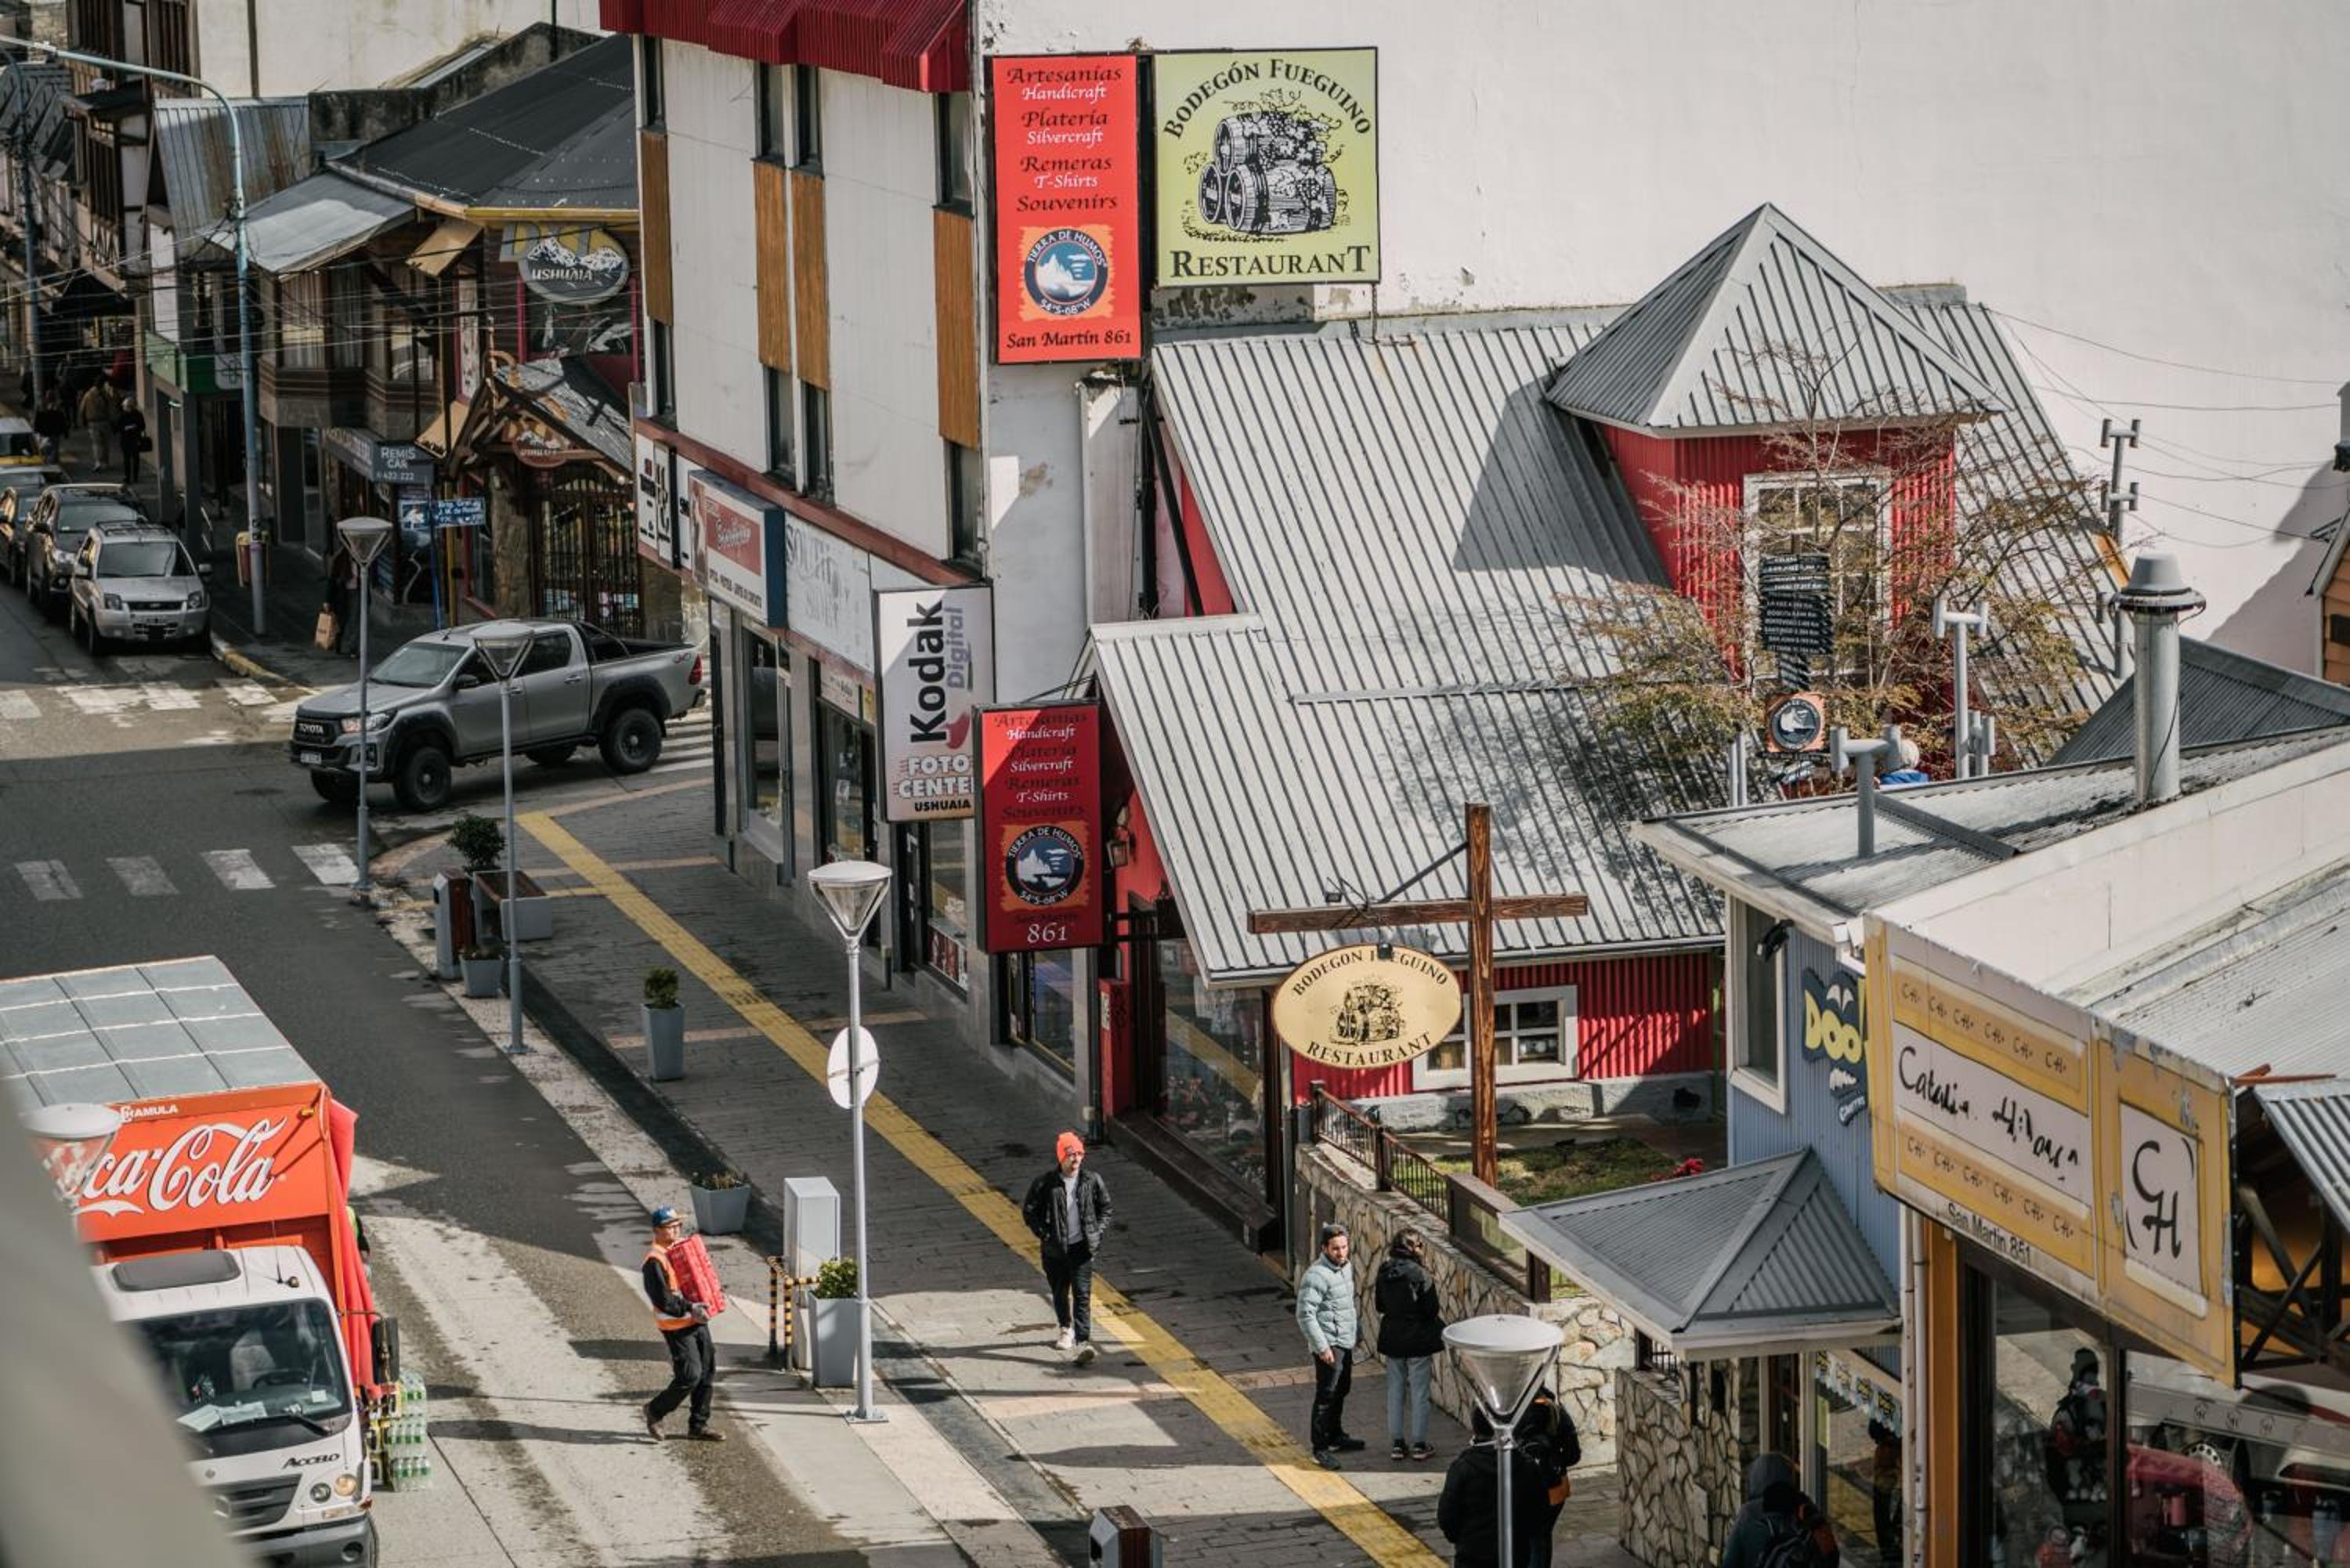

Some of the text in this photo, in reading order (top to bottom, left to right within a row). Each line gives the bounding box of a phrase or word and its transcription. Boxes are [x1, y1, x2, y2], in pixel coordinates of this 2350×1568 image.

[1022, 81, 1107, 105] Handicraft
[1269, 58, 1371, 135] FUEGUINO
[1027, 127, 1104, 149] Silvercraft
[1020, 157, 1112, 172] Remeras
[1034, 172, 1098, 189] T-Shirts
[1016, 193, 1118, 212] Souvenirs
[1170, 245, 1371, 278] RESTAURANT
[1006, 333, 1036, 349] San
[1104, 329, 1131, 345] 861
[381, 447, 416, 460] REMIS
[943, 607, 970, 689] Digital
[906, 600, 946, 742] Kodak
[1007, 724, 1076, 742] Handicraft
[907, 754, 971, 777] FOTO
[1010, 756, 1073, 775] Silvercraft
[898, 776, 975, 798] CENTE
[1016, 789, 1069, 803] T-Shirts
[914, 799, 971, 812] USHUAIA
[1027, 923, 1067, 943] 861
[1307, 1031, 1432, 1066] RESTAURANT
[1948, 1203, 1969, 1225] San
[2010, 1237, 2031, 1265] 851
